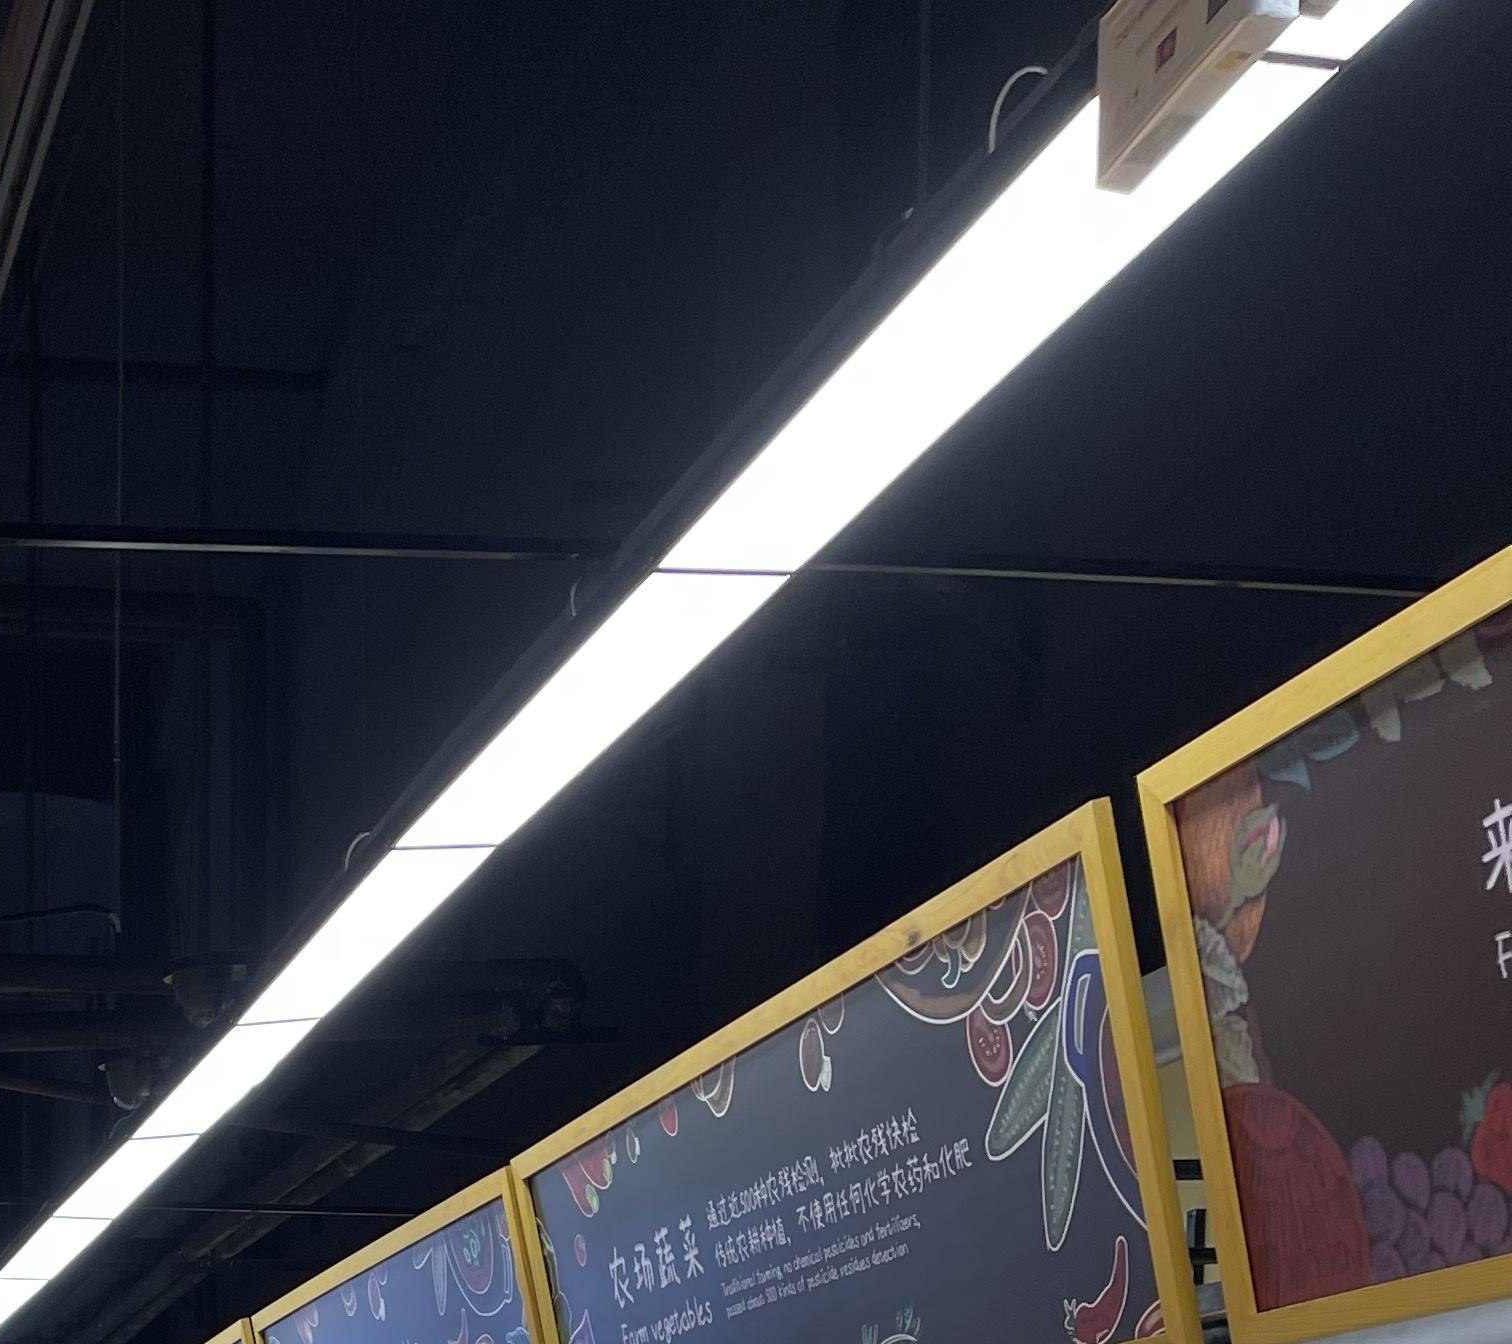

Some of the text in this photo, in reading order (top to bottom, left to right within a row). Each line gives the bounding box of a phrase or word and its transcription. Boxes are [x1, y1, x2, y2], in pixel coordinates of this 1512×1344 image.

[860, 1229, 874, 1247] and
[608, 1213, 706, 1309] 农场蔬菜
[650, 1299, 714, 1344] vegetables
